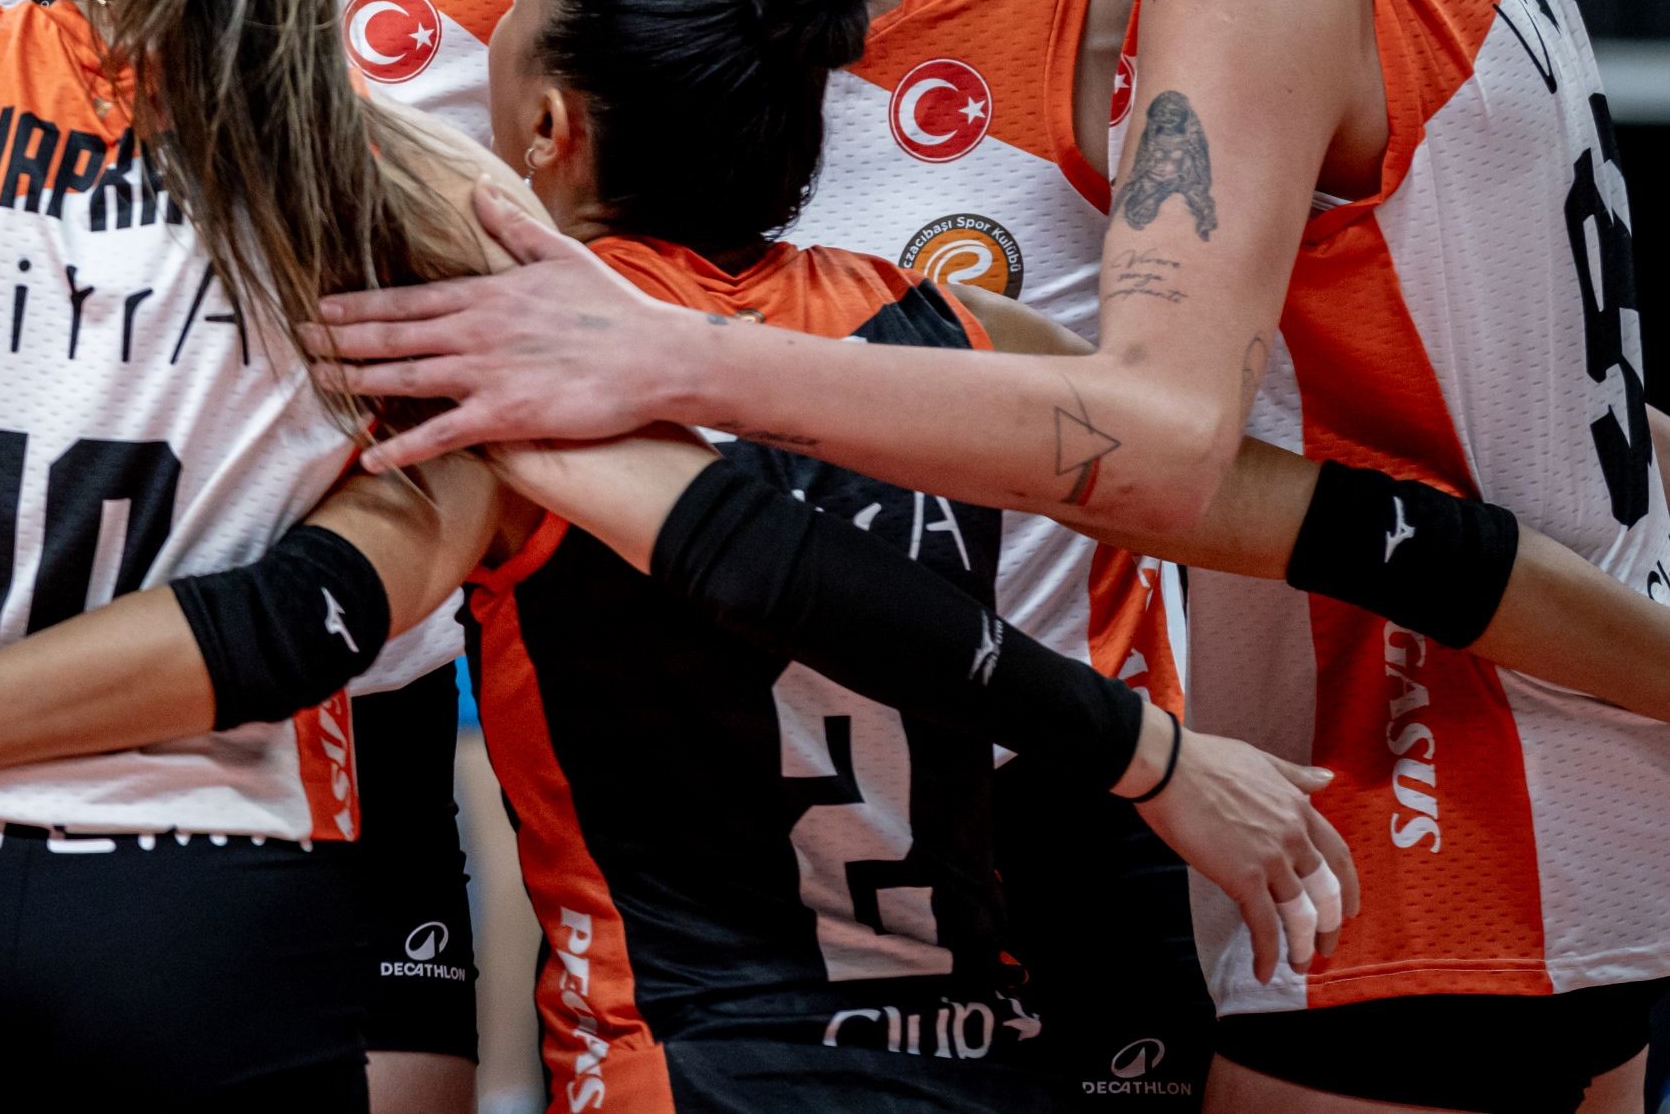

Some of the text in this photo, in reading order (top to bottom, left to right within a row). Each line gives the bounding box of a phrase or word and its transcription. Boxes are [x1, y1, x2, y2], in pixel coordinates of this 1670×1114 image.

[903, 216, 1023, 272] czacıbaşı Spor Kulübü
[1384, 619, 1442, 855] GASUS
[771, 660, 953, 982] 2
[380, 961, 466, 982] DECATHLON
[1081, 1081, 1192, 1096] DECATHLON
